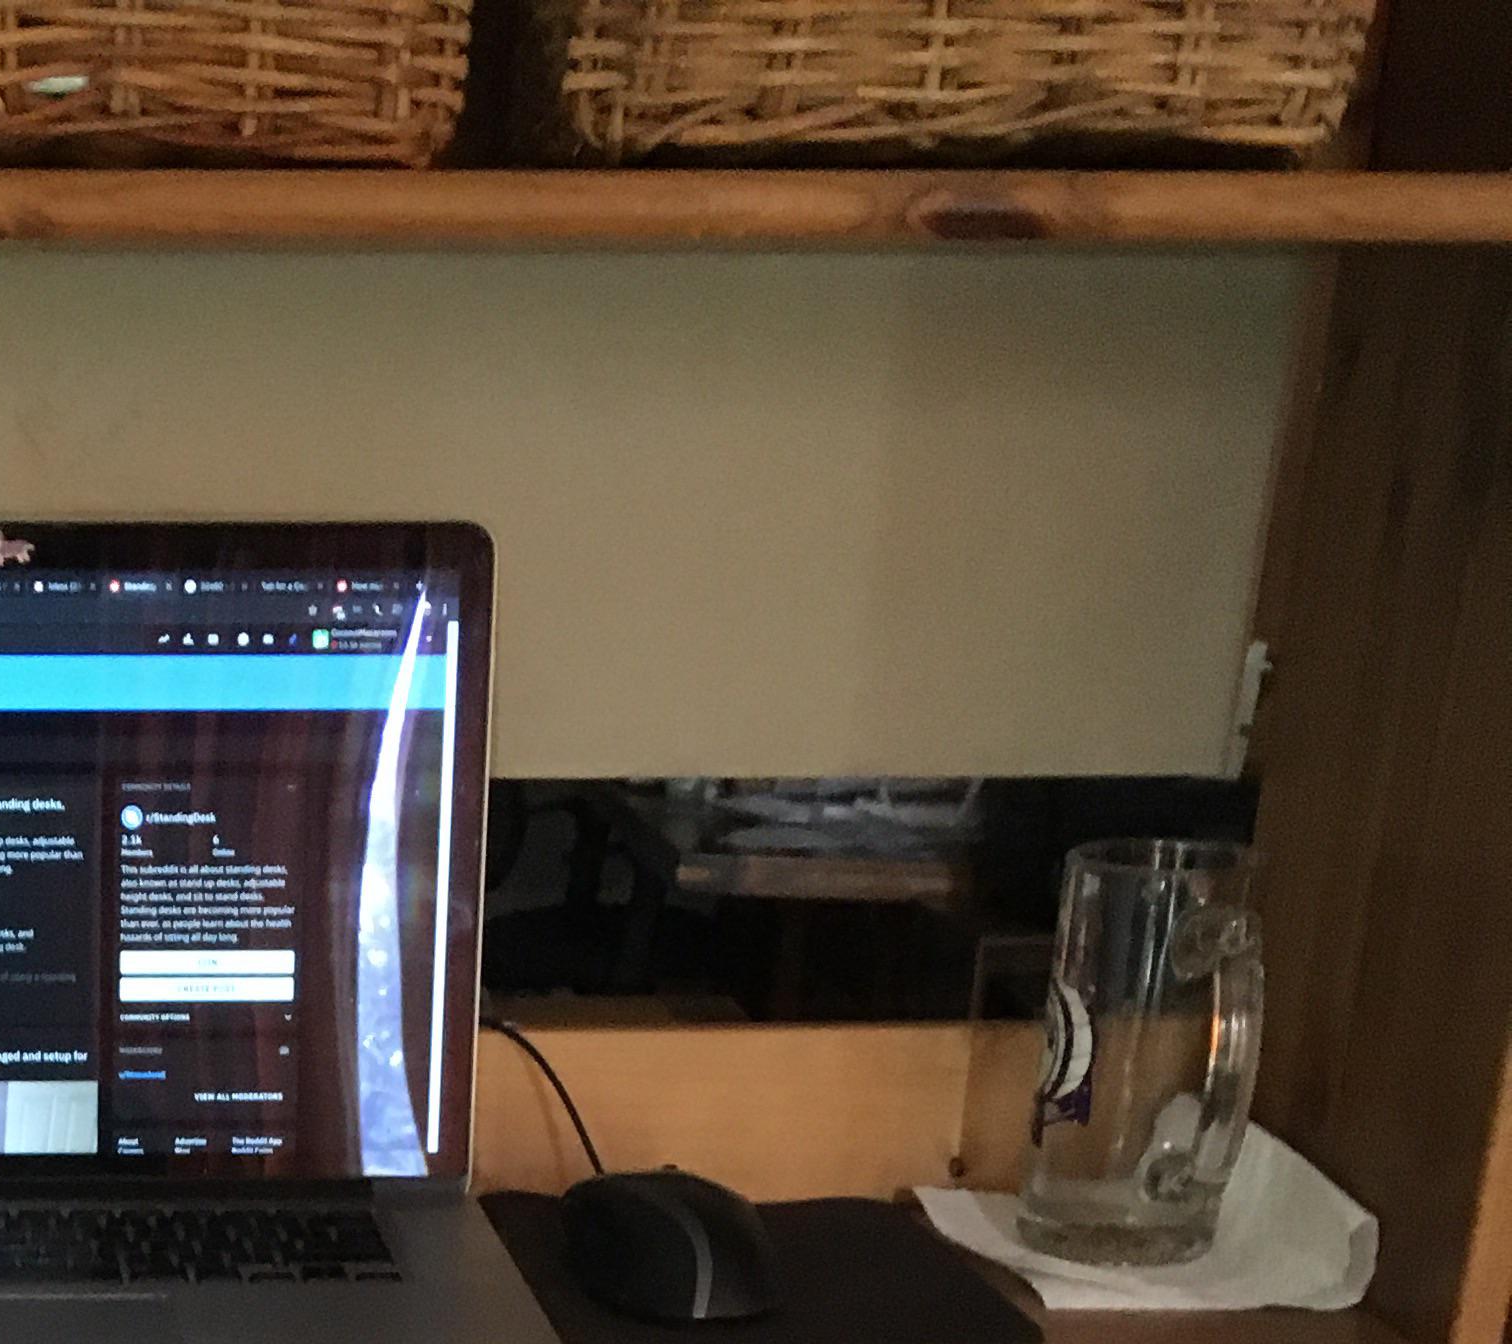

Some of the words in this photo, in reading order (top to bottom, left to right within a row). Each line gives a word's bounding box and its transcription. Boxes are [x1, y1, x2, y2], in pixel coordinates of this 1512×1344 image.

[145, 812, 217, 826] r/StandingDesk
[22, 1051, 42, 1064] and
[43, 1051, 72, 1064] setup
[73, 1051, 88, 1064] for
